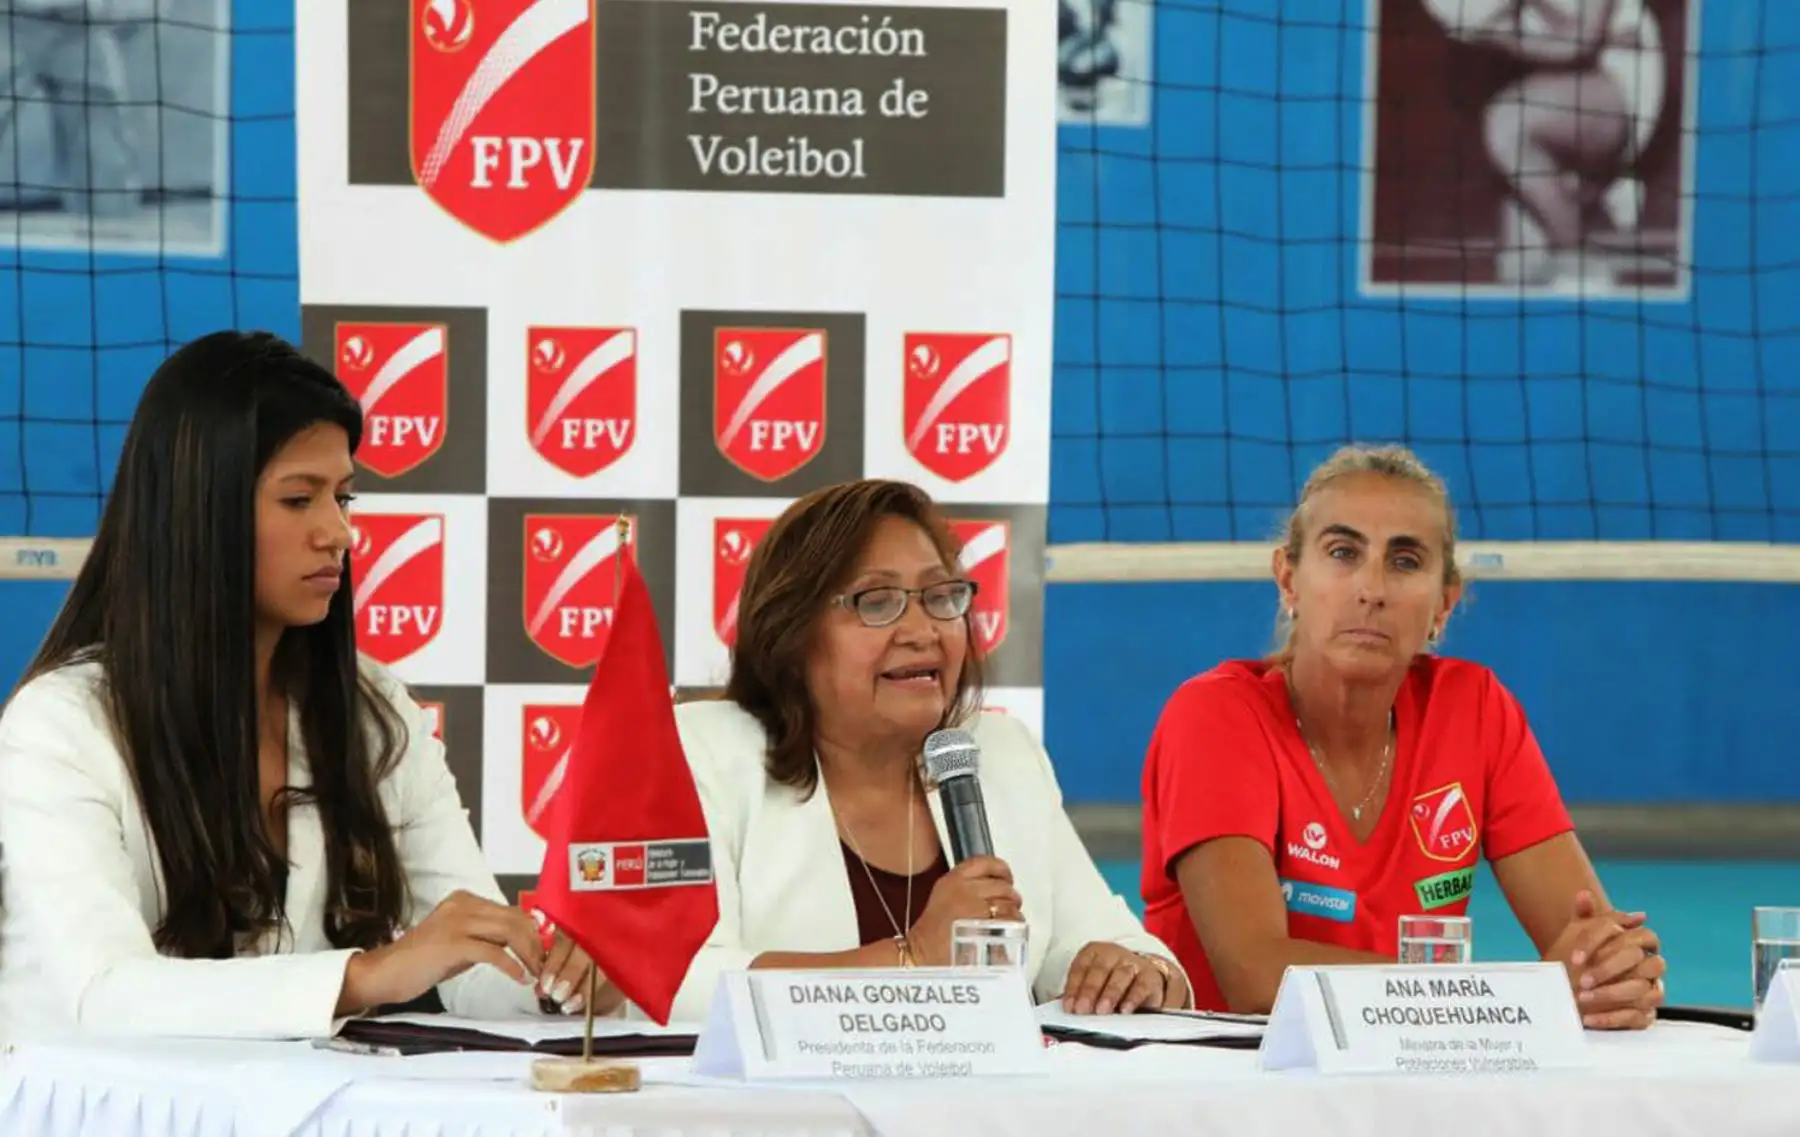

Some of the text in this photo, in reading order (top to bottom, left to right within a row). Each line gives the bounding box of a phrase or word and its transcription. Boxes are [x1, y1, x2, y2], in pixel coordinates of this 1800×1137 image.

[688, 12, 926, 57] Federación
[688, 74, 929, 118] Peruana de
[470, 136, 584, 190] FPV
[688, 134, 866, 179] Voleibol
[370, 415, 440, 447] FPV
[561, 418, 631, 450] FPV
[749, 420, 819, 452] FPV
[936, 423, 1005, 455] FPV
[366, 605, 437, 637] FPV
[1439, 828, 1474, 849] FPV
[1287, 842, 1340, 870] WALON
[789, 985, 980, 1004] DIANA GONZALES
[1385, 975, 1495, 998] ANA MARÍA
[839, 1014, 946, 1032] DELGADO
[1362, 1007, 1532, 1026] CHOQUEHUANCA
